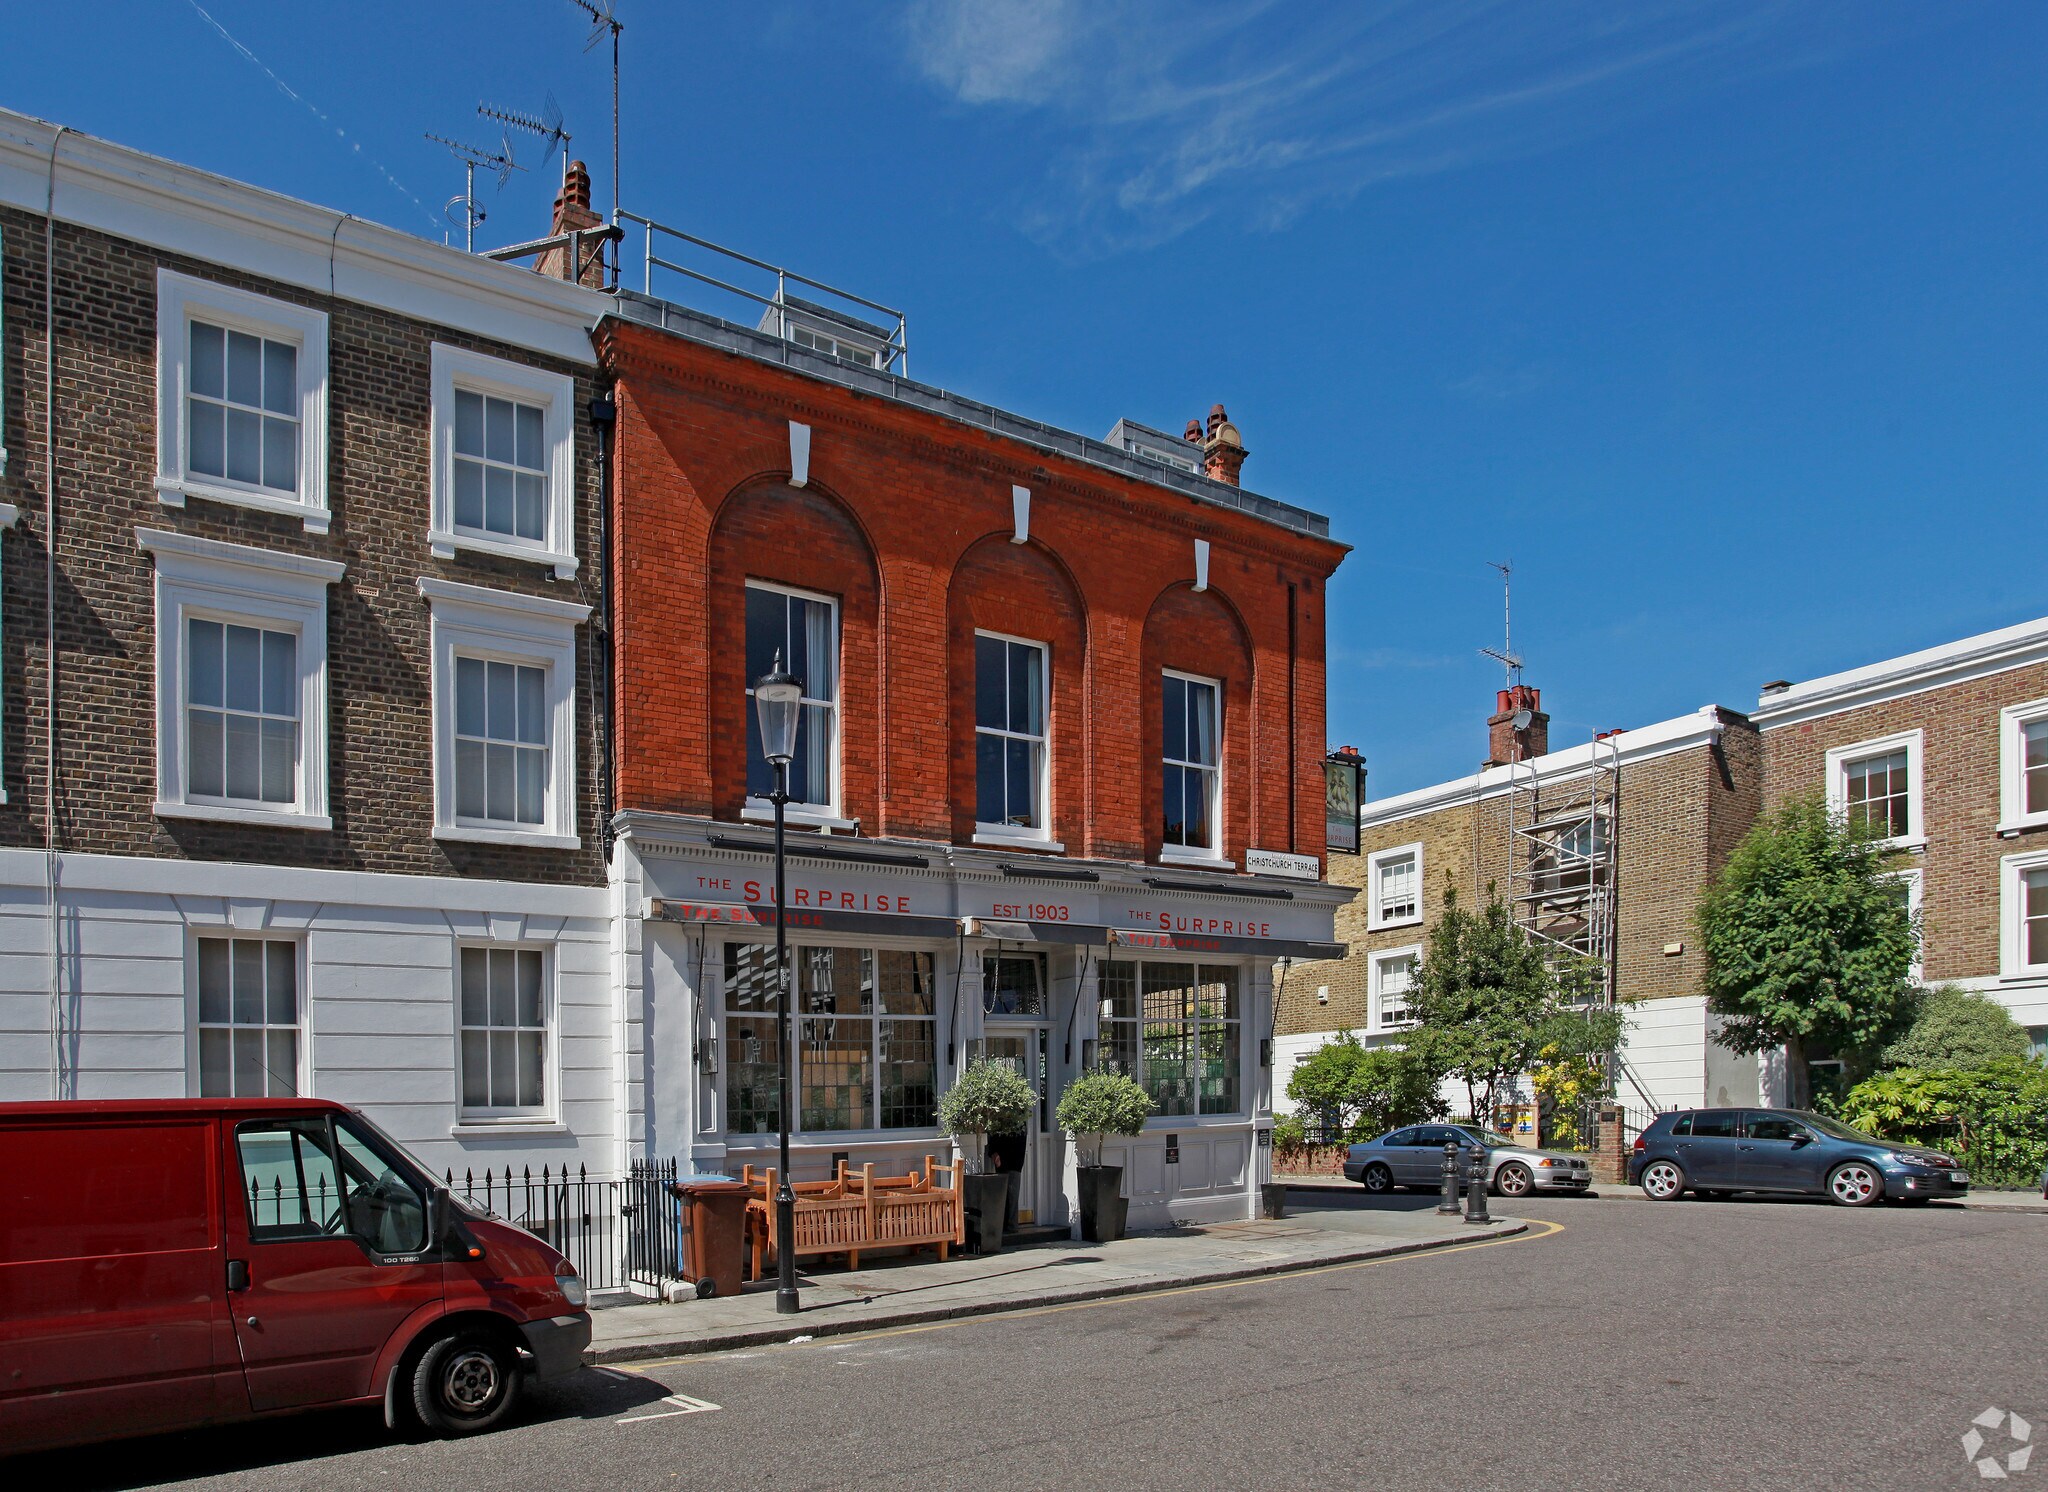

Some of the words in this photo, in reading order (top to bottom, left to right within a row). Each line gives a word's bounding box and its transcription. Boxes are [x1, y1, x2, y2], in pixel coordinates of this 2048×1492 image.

[1247, 856, 1292, 870] CHRISTCHURCH
[1294, 861, 1318, 873] TERRACE
[697, 877, 732, 890] THE
[680, 905, 722, 921] THE
[993, 904, 1021, 918] EST
[1028, 904, 1069, 921] 1903
[1129, 910, 1152, 921] THE
[1159, 912, 1270, 937] SURPRISE
[1128, 933, 1154, 947] THE
[1159, 935, 1221, 950] SURPRISE
